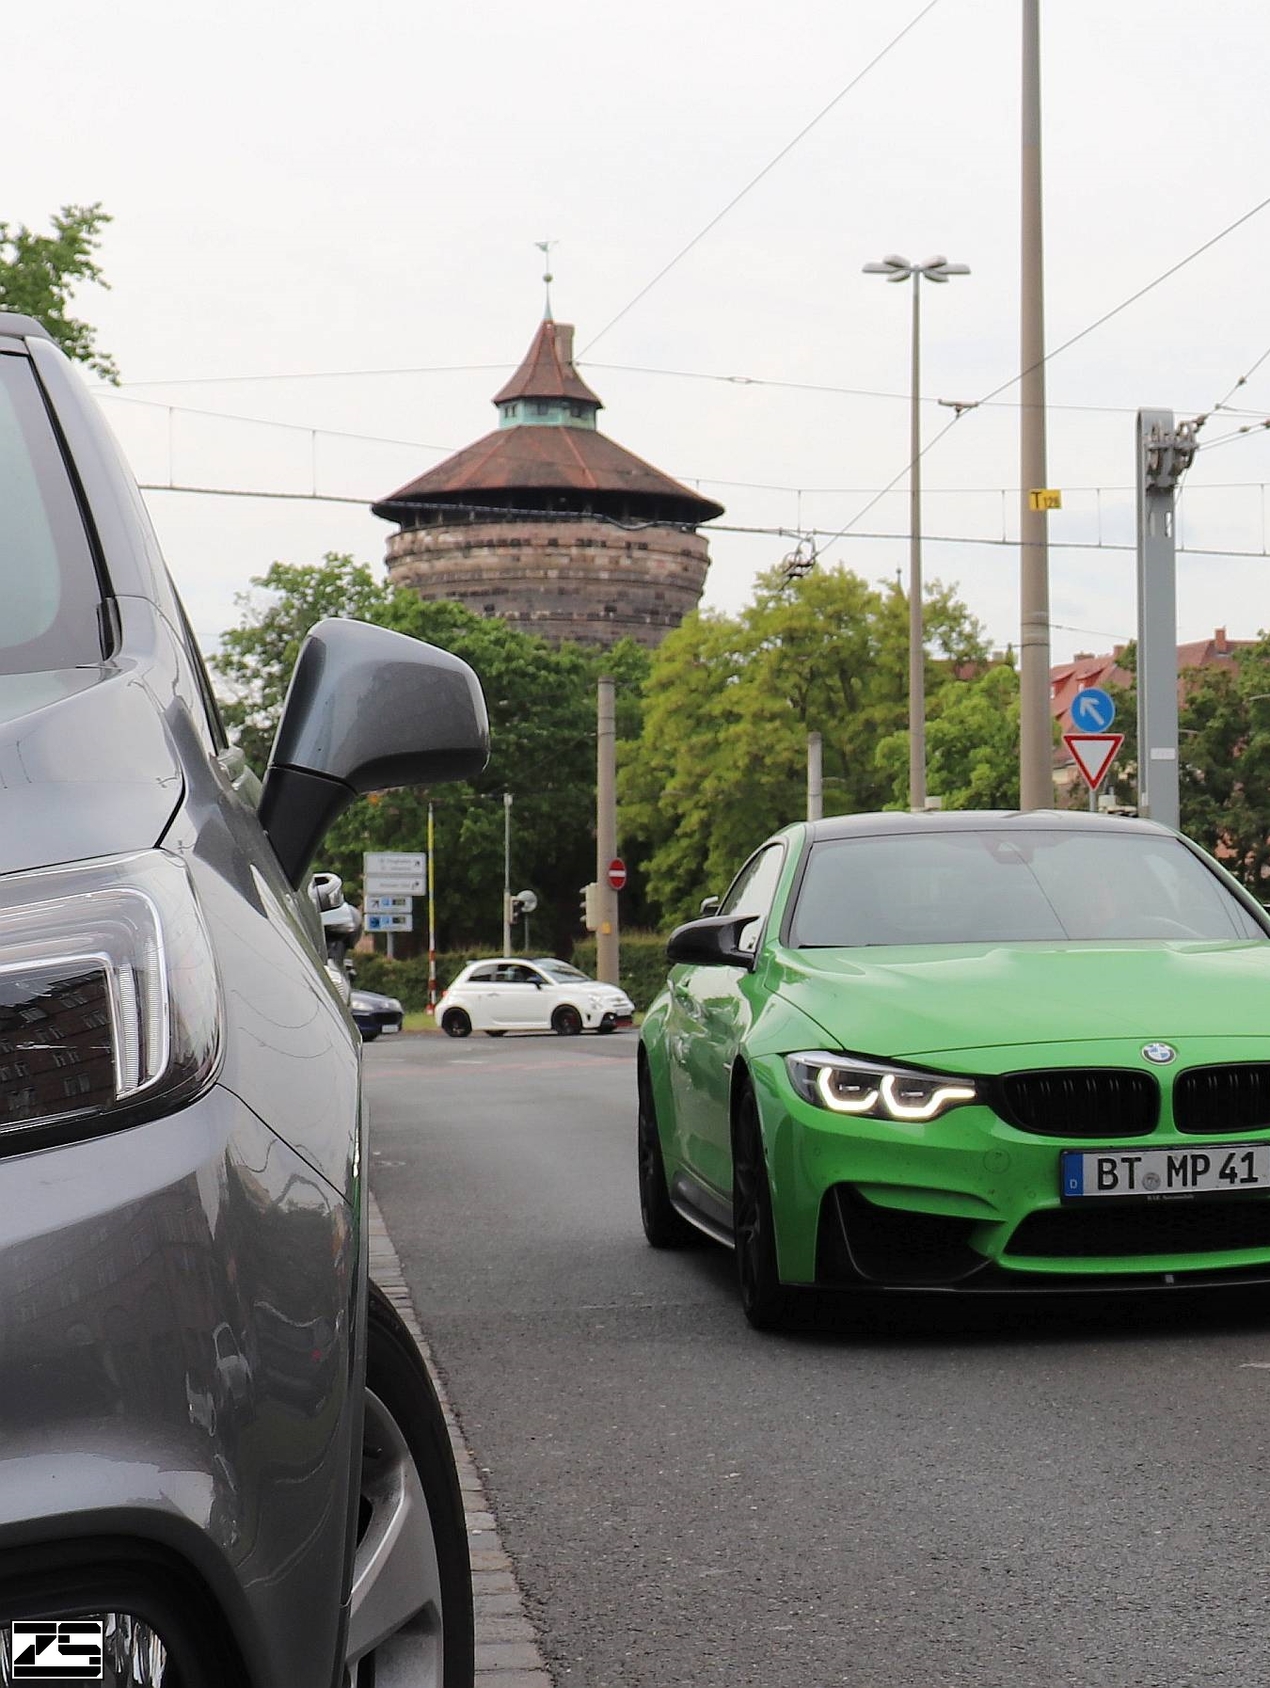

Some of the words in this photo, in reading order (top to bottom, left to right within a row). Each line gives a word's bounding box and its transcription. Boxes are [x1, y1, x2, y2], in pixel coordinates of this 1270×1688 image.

[1097, 1156, 1142, 1190] BT
[1167, 1153, 1211, 1187] MP
[1218, 1151, 1259, 1184] 41
[1069, 1178, 1078, 1189] D
